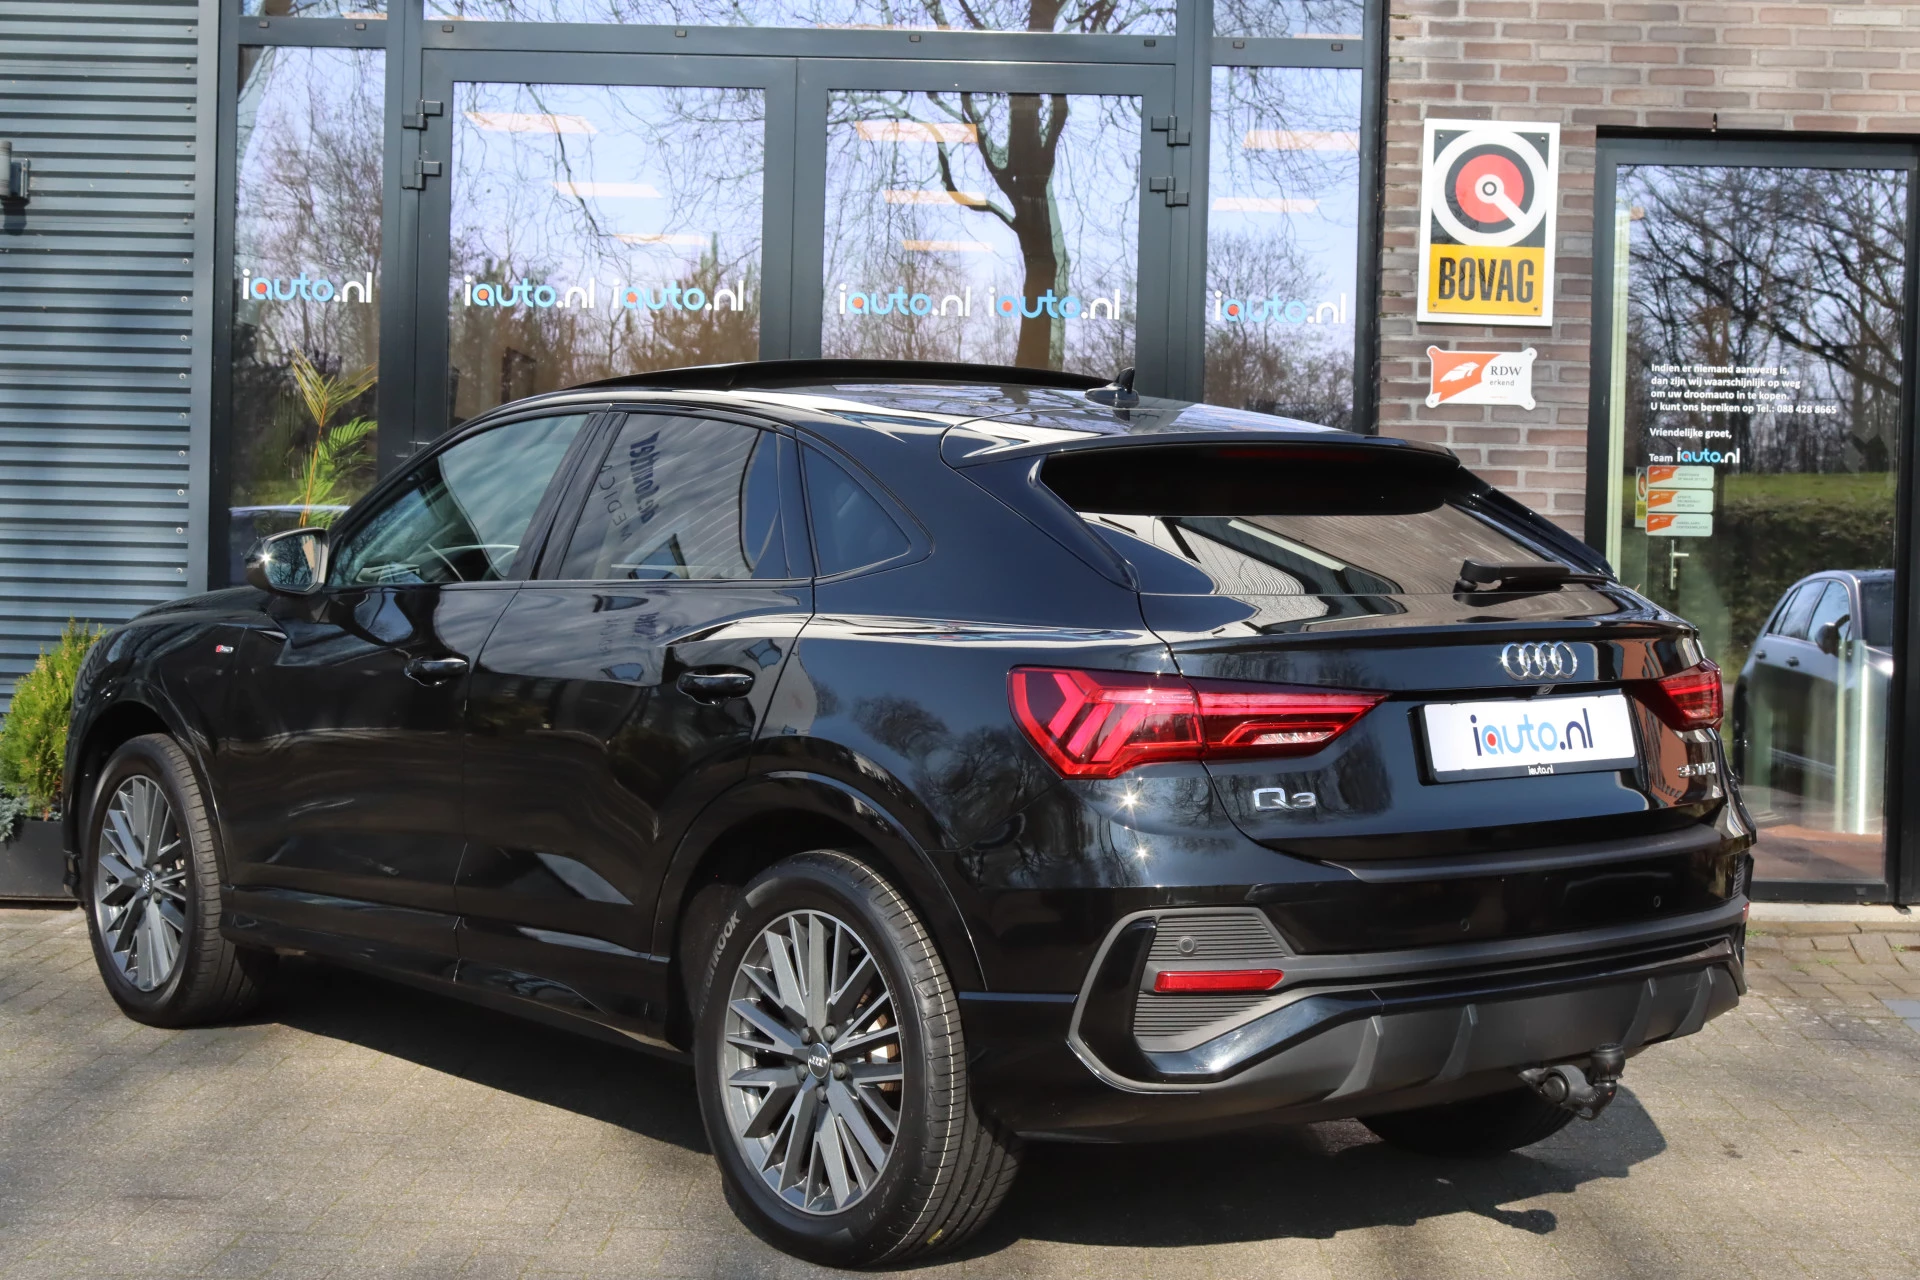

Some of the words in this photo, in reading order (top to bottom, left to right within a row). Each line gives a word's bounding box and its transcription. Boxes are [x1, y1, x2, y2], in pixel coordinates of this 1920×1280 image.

[241, 268, 373, 303] iauto.nl
[1438, 256, 1535, 304] BOVAG
[464, 274, 595, 309] iauto.nl
[613, 278, 744, 312] iauto.nl
[839, 282, 971, 317] iauto.nl
[988, 286, 1120, 321] iauto.nl
[1214, 290, 1346, 325] iauto.nl
[1490, 365, 1522, 376] RDW
[1651, 363, 1680, 373] Indien
[1682, 365, 1692, 373] er
[1693, 364, 1734, 374] niemand
[1735, 365, 1778, 376] aanwezig
[1489, 379, 1515, 387] erkend
[1650, 376, 1669, 385] dan
[1670, 376, 1686, 387] zijn
[1688, 377, 1702, 388] wij
[1703, 377, 1766, 389] waarschijnlijk
[1767, 380, 1780, 389] op
[1781, 380, 1801, 390] weg
[1650, 390, 1666, 398] om
[1667, 390, 1682, 398] uw
[1683, 389, 1735, 400] droomauto
[1736, 390, 1746, 400] in
[1747, 391, 1757, 400] te
[1758, 391, 1790, 402] kopen.
[1650, 402, 1658, 411] U
[1659, 402, 1681, 411] kunt
[1682, 404, 1699, 412] ons
[1700, 402, 1740, 413] bereiken
[1742, 405, 1755, 415] op
[1756, 404, 1775, 413] Tel.:
[1776, 404, 1794, 414] 088
[1795, 404, 1813, 414] 428
[1814, 405, 1837, 414] 8665
[1649, 427, 1704, 439] Vriendelijke
[1704, 429, 1732, 440] groet,
[1648, 453, 1674, 462] Team
[1676, 446, 1741, 464] iauto.nl
[1470, 707, 1594, 757] iauto.nl
[1252, 787, 1317, 812] Q3
